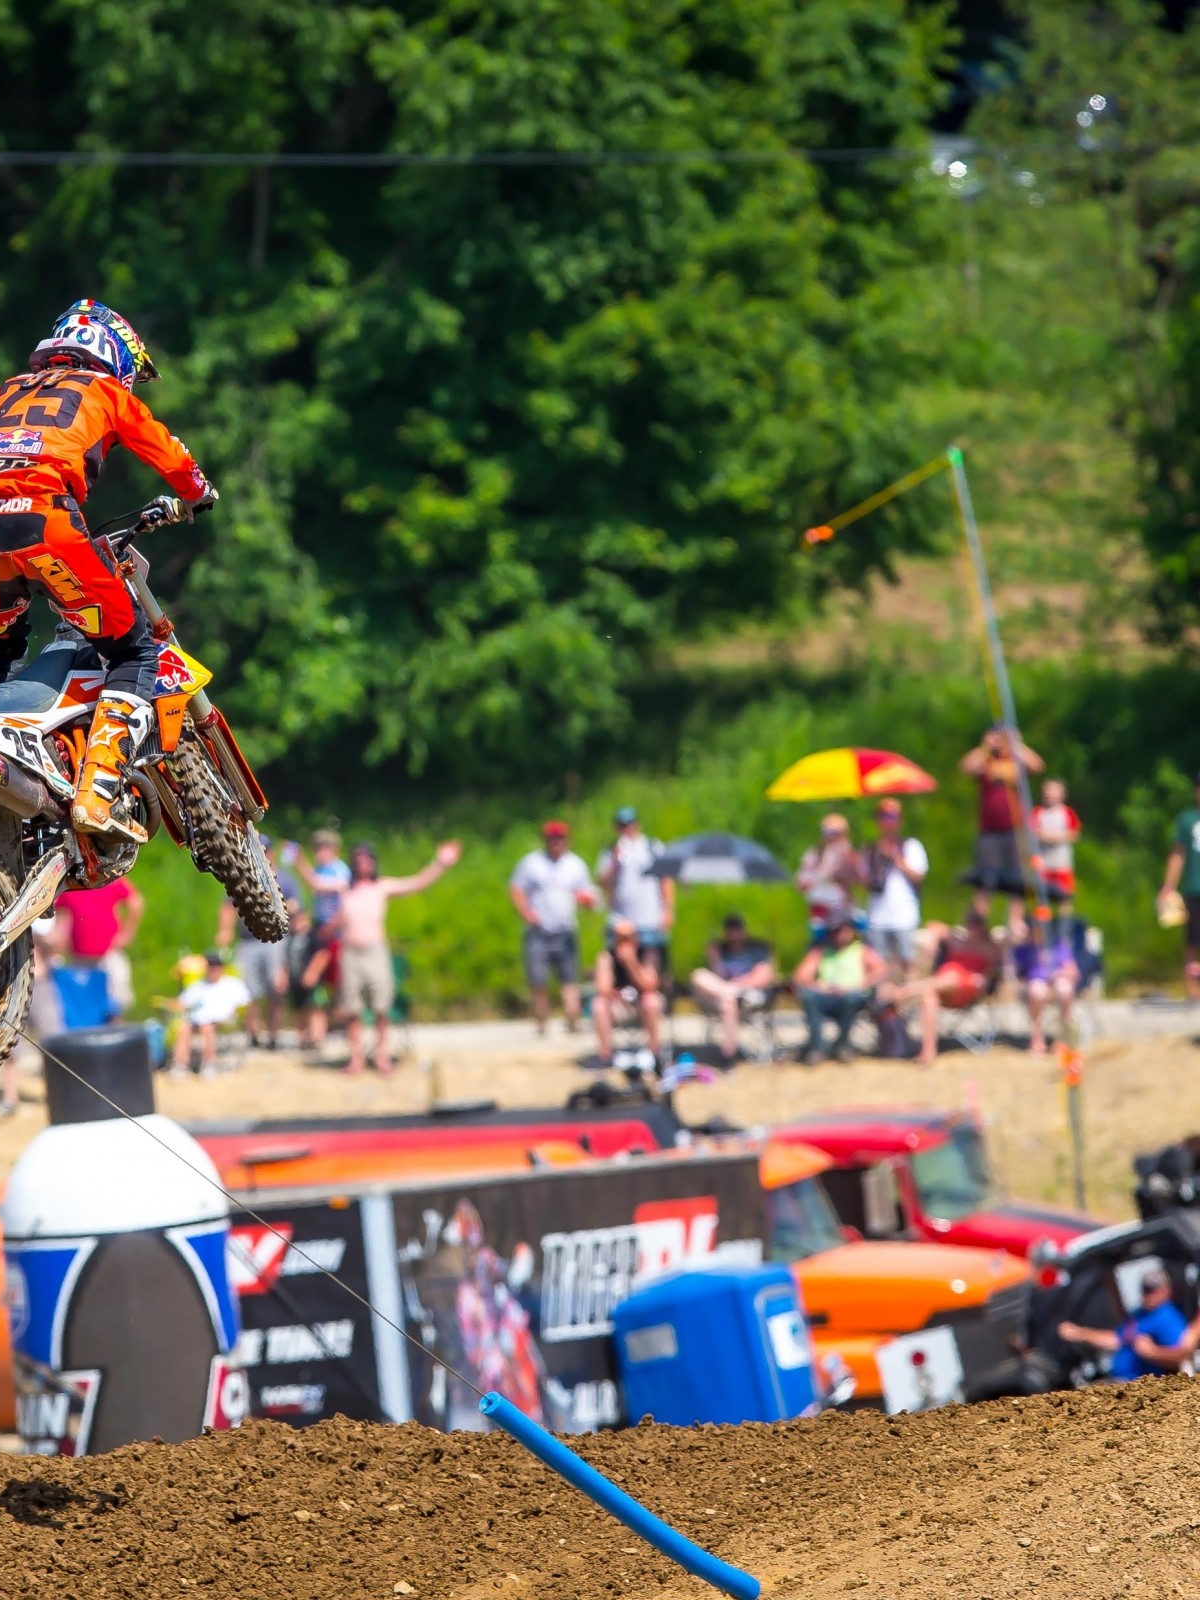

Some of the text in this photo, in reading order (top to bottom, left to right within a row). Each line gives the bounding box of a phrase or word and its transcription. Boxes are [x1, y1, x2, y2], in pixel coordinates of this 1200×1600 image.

[11, 441, 42, 455] Bull
[28, 554, 85, 602] KTM
[1, 727, 44, 771] 25
